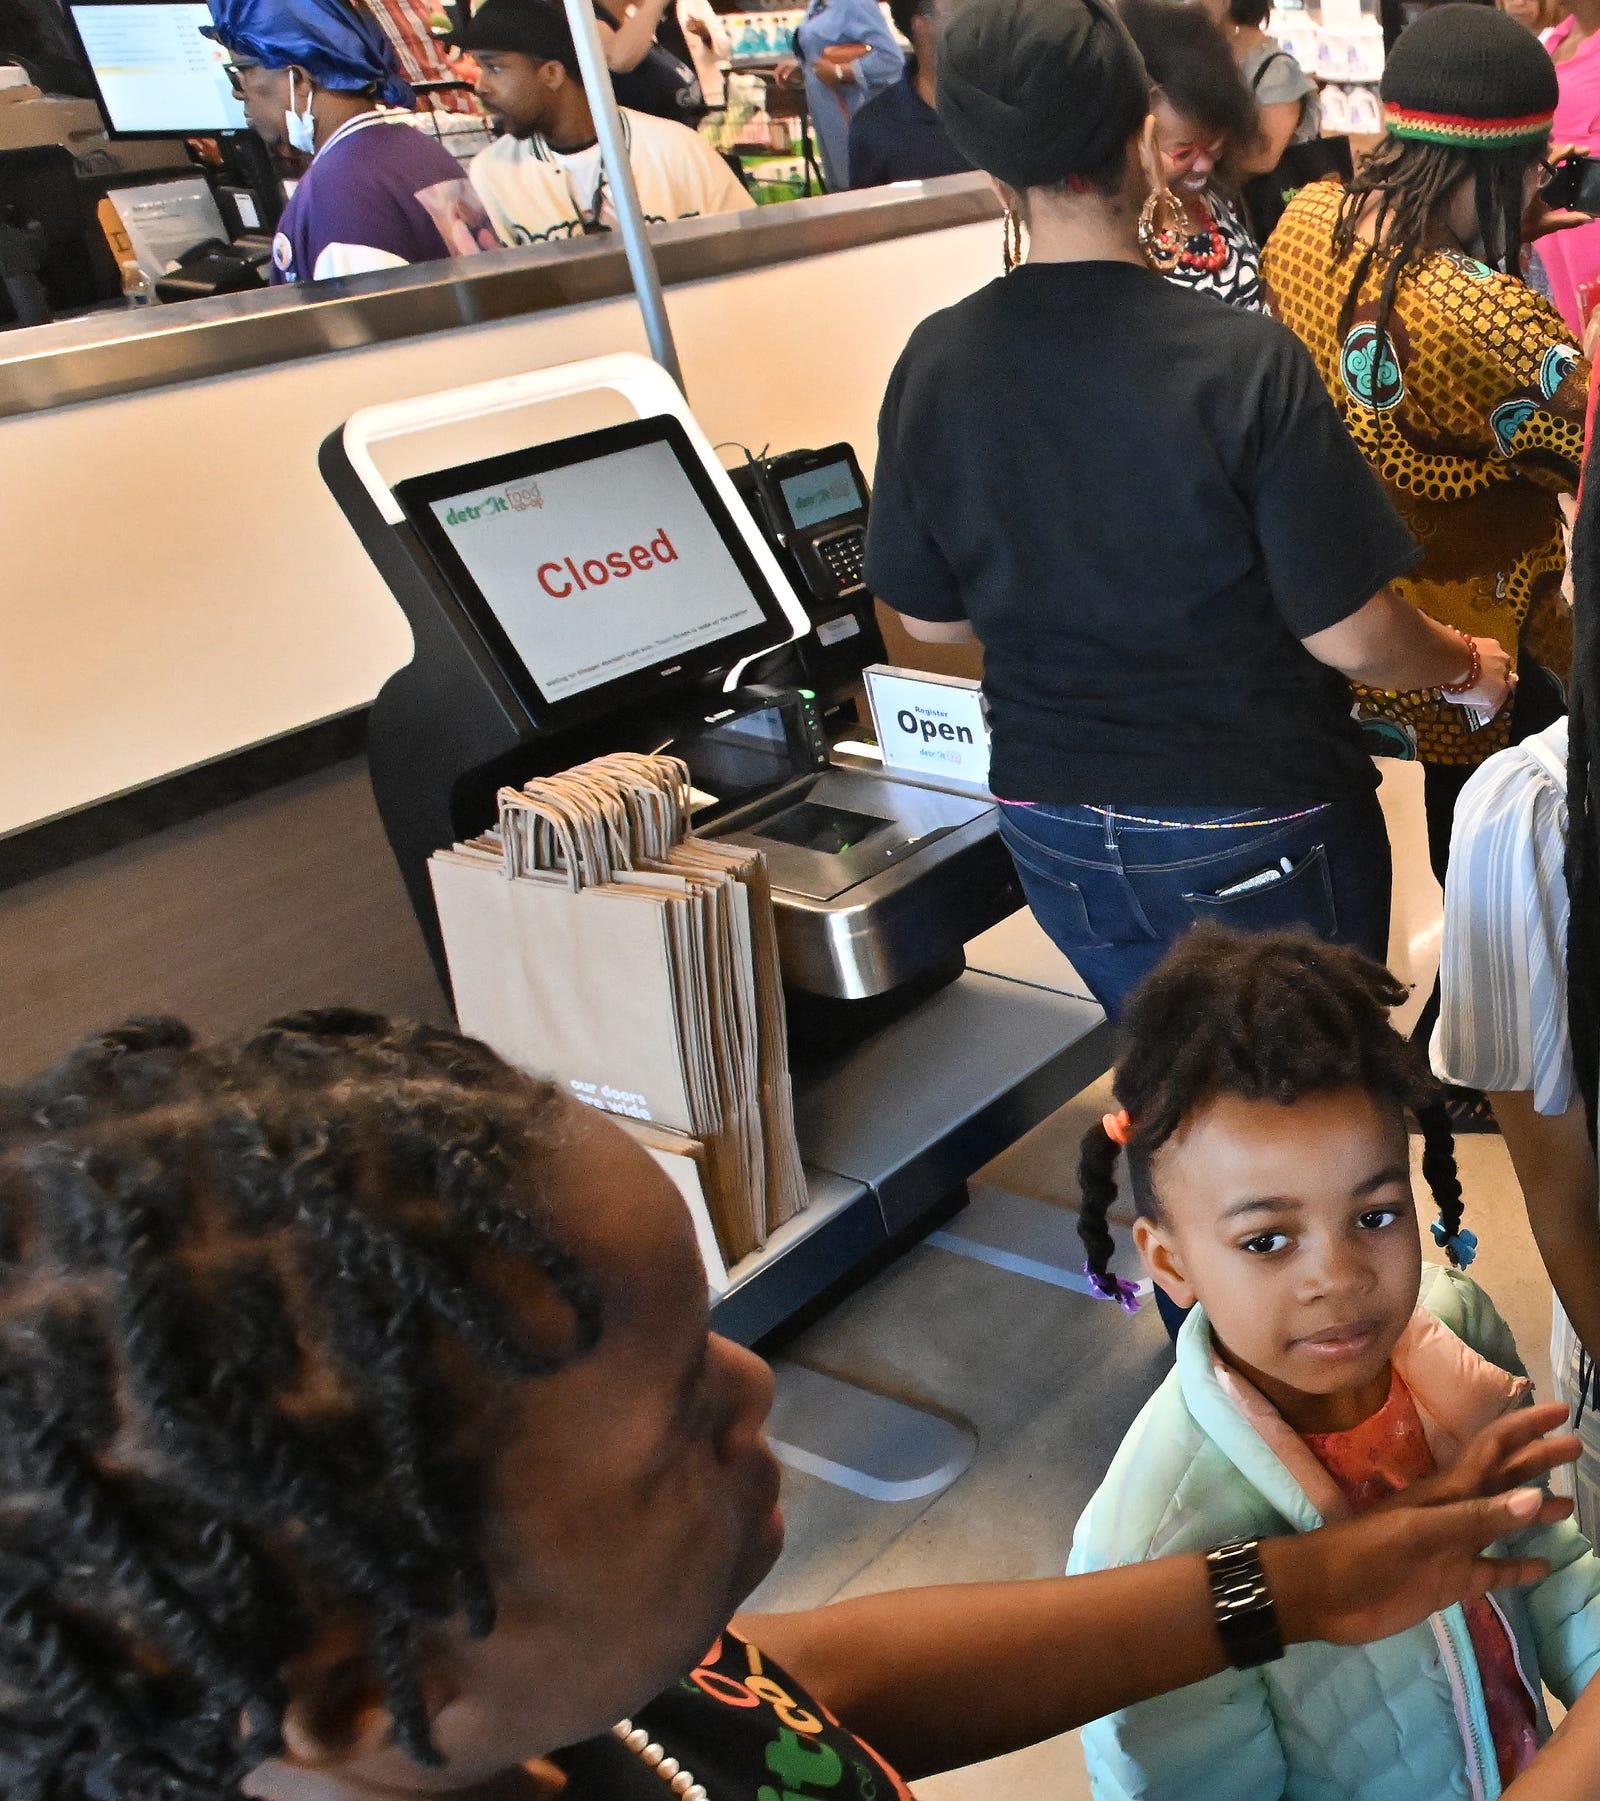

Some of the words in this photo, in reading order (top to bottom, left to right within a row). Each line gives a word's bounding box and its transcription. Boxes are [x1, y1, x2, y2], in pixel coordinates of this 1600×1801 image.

[537, 528, 678, 598] Closed
[915, 706, 948, 717] Register
[897, 710, 973, 744] Open
[570, 1079, 597, 1094] our
[601, 1085, 647, 1105] doors
[606, 1101, 652, 1120] wide
